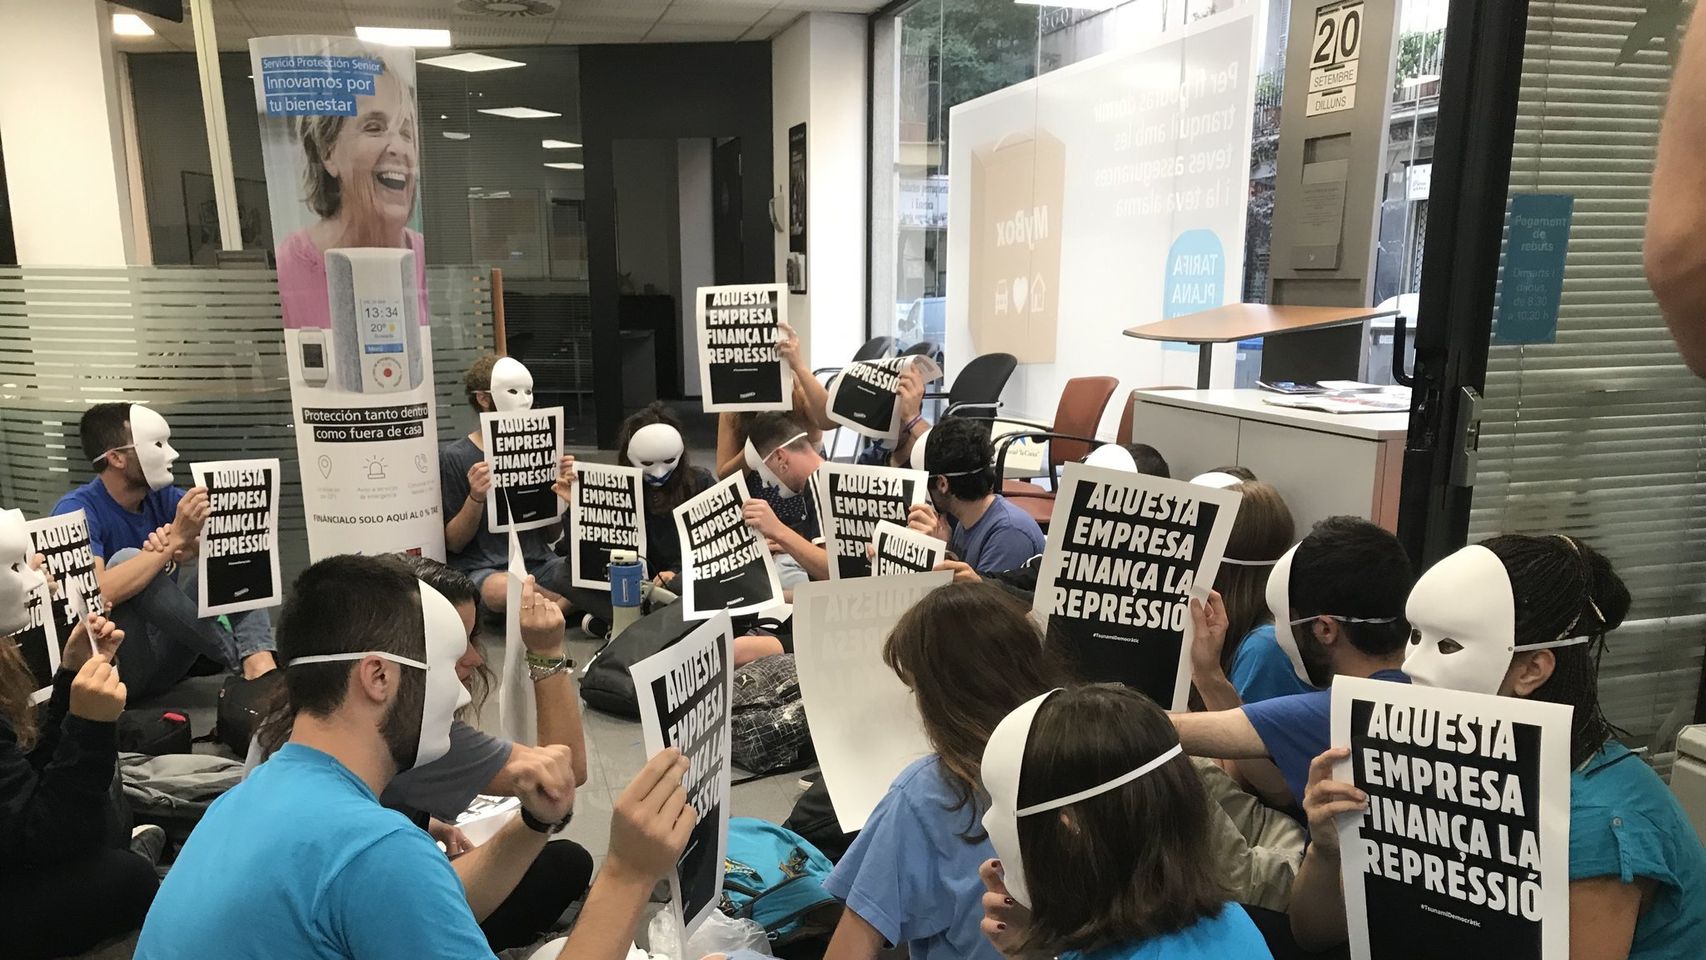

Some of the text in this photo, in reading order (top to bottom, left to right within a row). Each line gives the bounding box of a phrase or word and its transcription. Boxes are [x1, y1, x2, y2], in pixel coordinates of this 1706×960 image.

[1314, 10, 1360, 63] 20
[263, 57, 380, 72] Servicio Protección Senior
[266, 76, 371, 92] Innovamos por
[1314, 69, 1354, 88] SETEMBRE
[269, 97, 352, 112] tu bienestar
[1315, 95, 1347, 111] DILLUNS
[1515, 214, 1566, 229] Pagament
[1532, 229, 1546, 240] de
[1521, 240, 1554, 252] rebuts
[712, 290, 770, 306] AQUESTA
[365, 306, 398, 319] 13:34
[709, 308, 774, 325] EMPRESA
[707, 327, 780, 350] FINANÇA LA
[304, 405, 428, 422] Protección tanto dentro
[316, 424, 422, 440] como fuera de casa
[497, 416, 551, 434] AQUESTA
[496, 432, 553, 452] EMPRESA
[494, 449, 557, 471] FINANÇA LA
[213, 468, 266, 489] AQUESTA
[494, 464, 557, 488] REPRESSIÓ
[583, 471, 629, 490] AQUESTA
[837, 473, 904, 497] AQUESTA
[210, 490, 267, 512] EMPRESA
[582, 488, 633, 509] EMPRESA
[687, 487, 735, 526] AQUESTA
[835, 496, 907, 521] EMPRESA
[1086, 482, 1200, 527] AQUESTA
[206, 510, 271, 537] FINANÇA LA
[359, 514, 384, 524] SOLO
[386, 511, 409, 523] AQUÍ
[409, 511, 419, 519] AL
[579, 506, 638, 529] FINANÇA LA
[691, 504, 744, 546] EMPRESA
[834, 517, 875, 538] FINAN
[206, 530, 271, 558] REPRESSIÓ
[579, 525, 639, 547] REPRESSIÓ
[1072, 515, 1195, 562] EMPRESA
[691, 529, 742, 566] FINANÇA
[883, 533, 929, 569] AQUESTA
[693, 538, 763, 581] REPRESSIÓ
[1056, 550, 1195, 597] FINANÇA LA
[1050, 586, 1189, 632] REPRESSIÓ
[665, 638, 721, 714] AQUESTA
[668, 682, 723, 754] EMPRESA
[1367, 701, 1517, 762] AQUESTA
[1363, 748, 1525, 817] EMPRESA
[1358, 795, 1543, 873] FINANÇA LA
[1358, 838, 1543, 923] REPRESSIÓ
